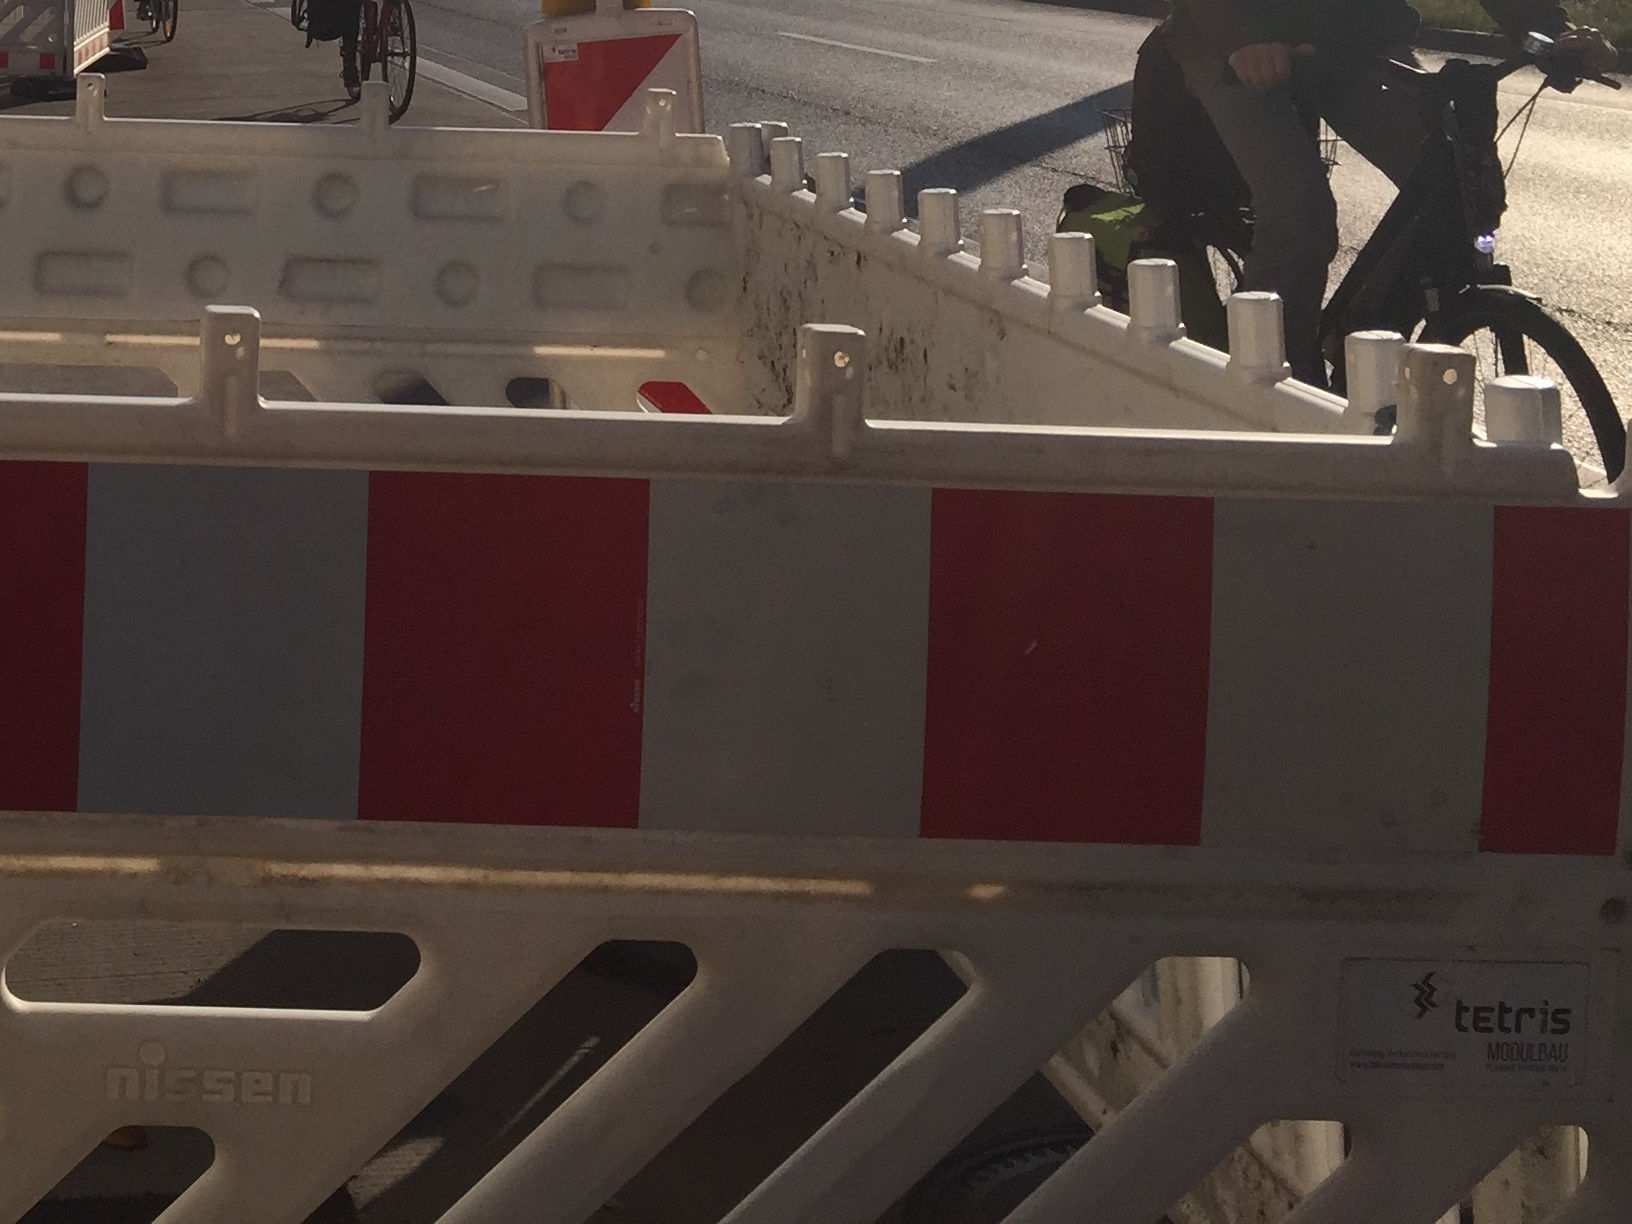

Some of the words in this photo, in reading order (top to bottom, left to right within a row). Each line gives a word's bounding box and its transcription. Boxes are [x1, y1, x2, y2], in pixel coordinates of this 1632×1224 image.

[1454, 1000, 1572, 1035] tetris
[1486, 1041, 1569, 1063] MODULBAU
[106, 1041, 313, 1104] nissen
